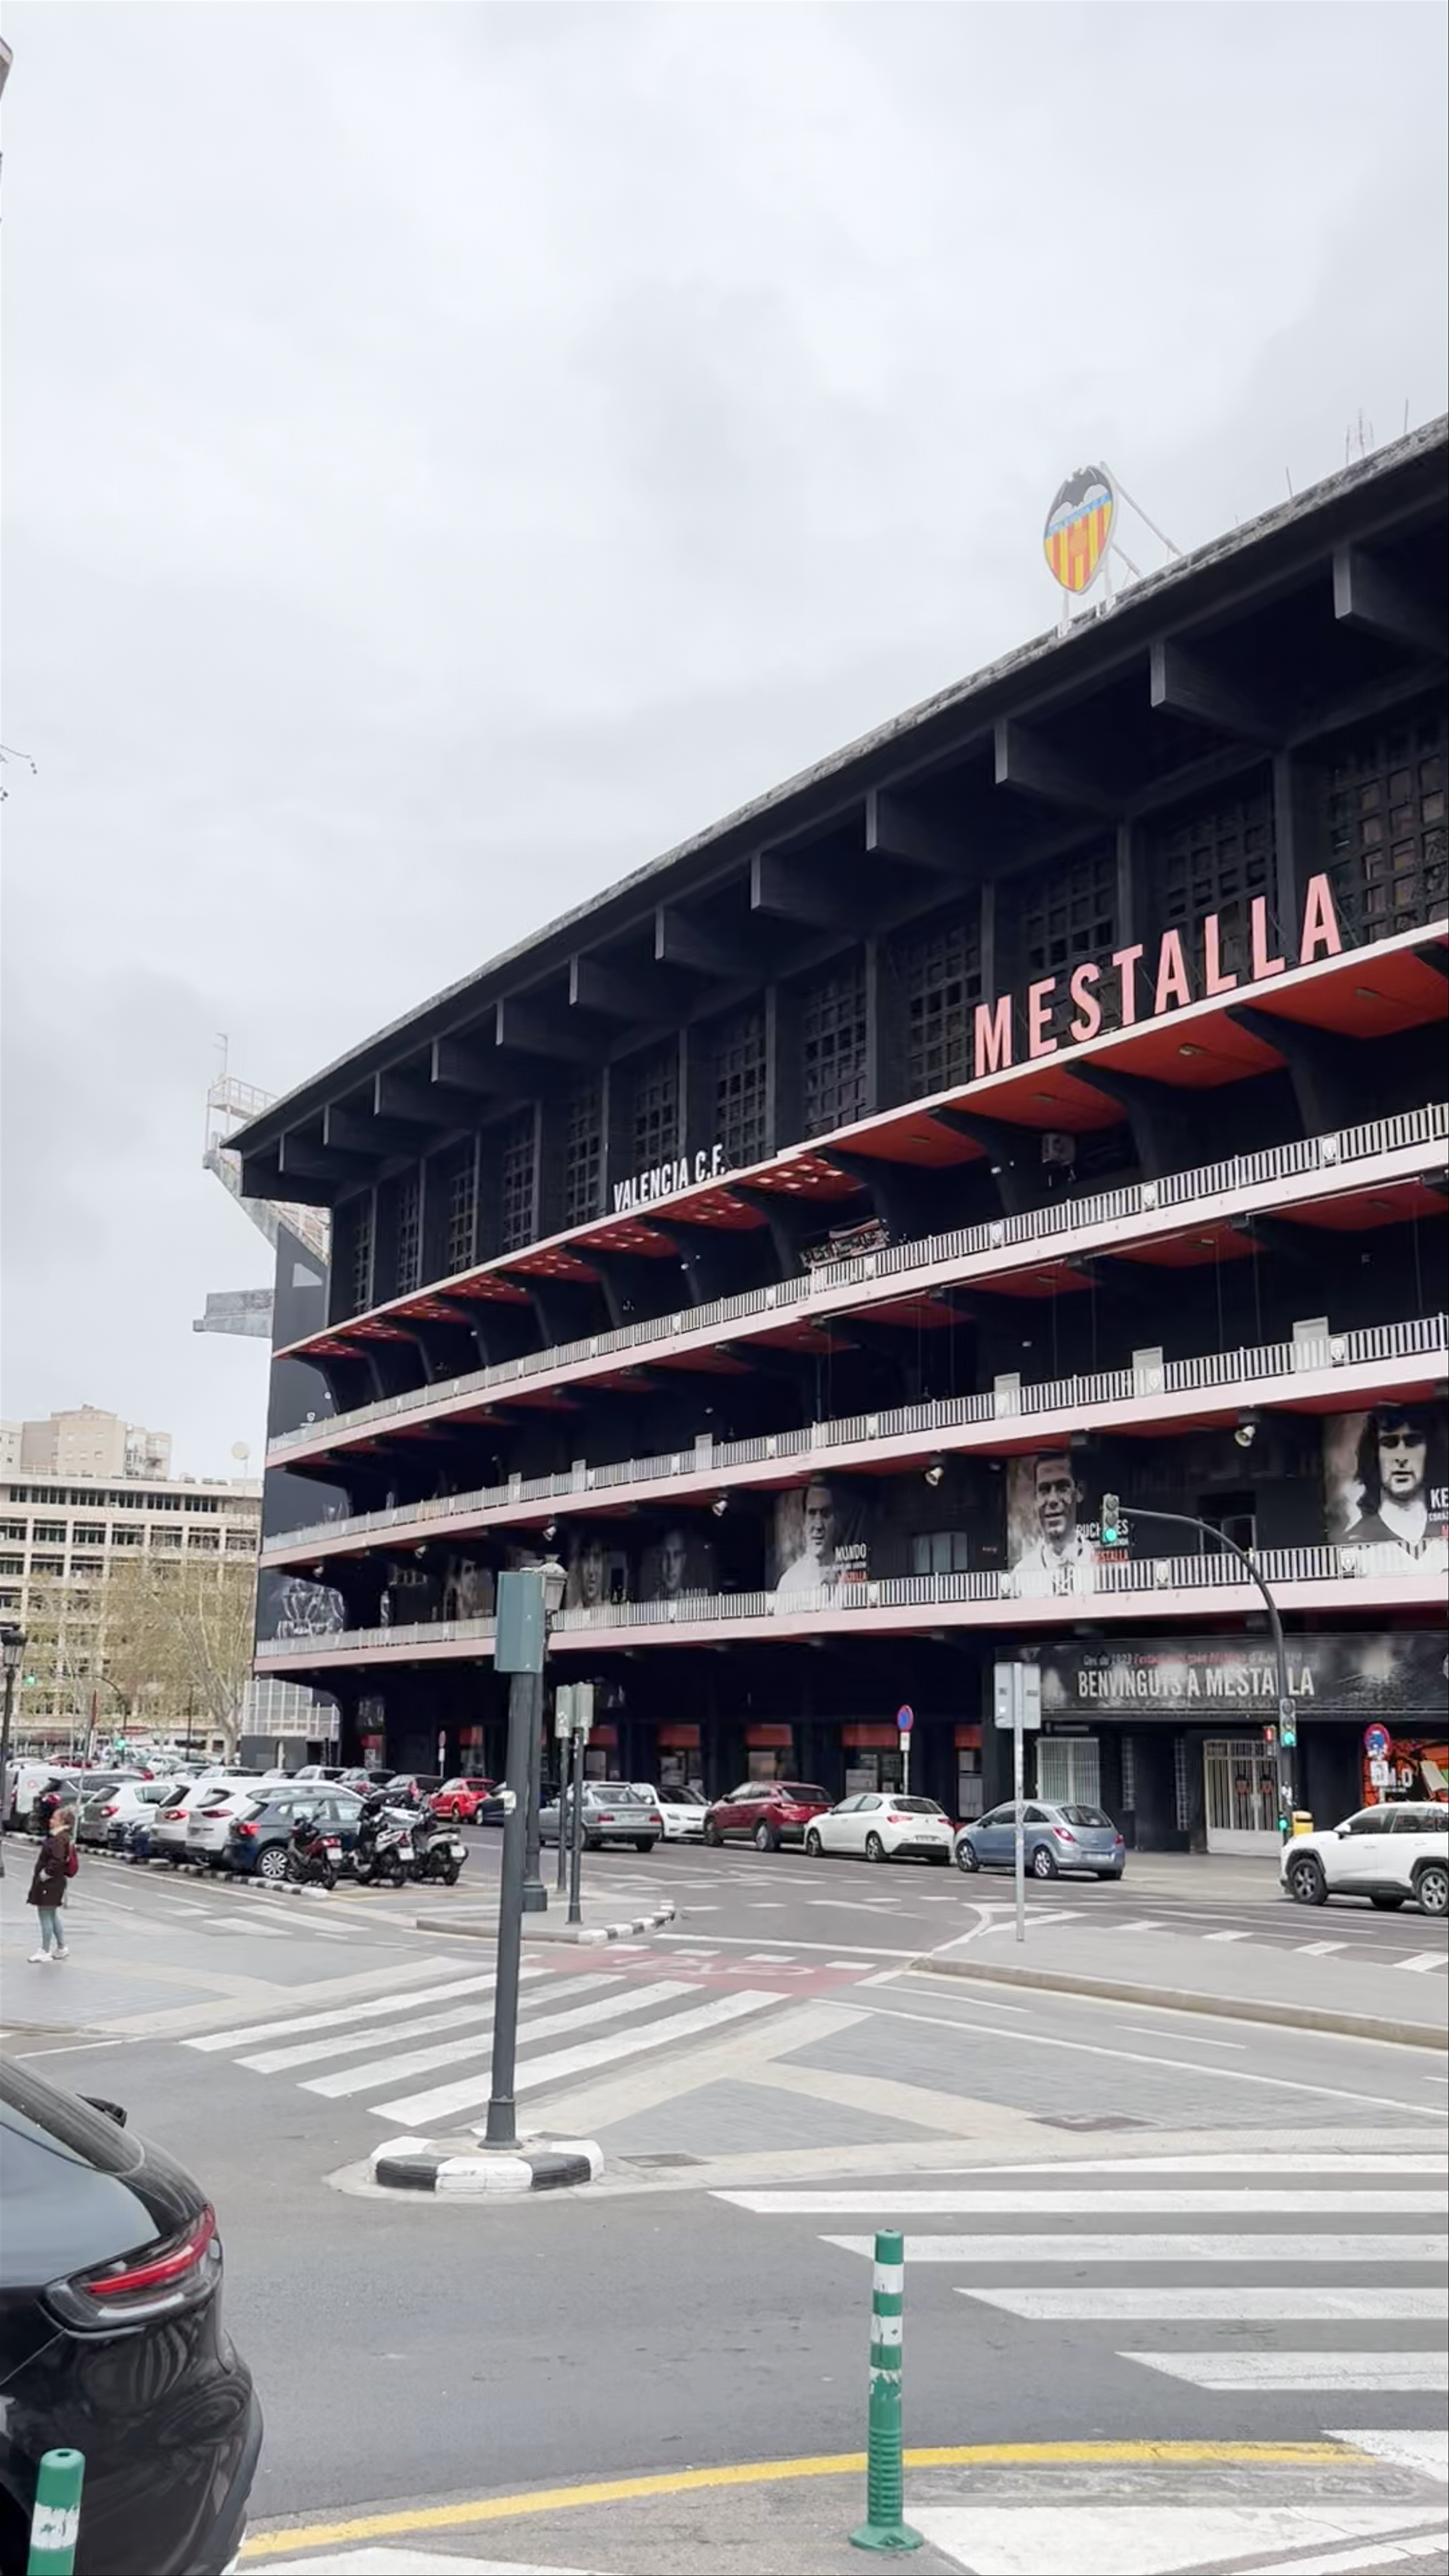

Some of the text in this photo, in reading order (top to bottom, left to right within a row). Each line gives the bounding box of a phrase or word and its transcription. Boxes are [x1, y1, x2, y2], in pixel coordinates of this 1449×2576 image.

[975, 873, 1342, 1077] MESTALLA
[614, 1144, 725, 1212] VALENCIA C.F.
[1076, 1519, 1128, 1538] PUCHES
[835, 1544, 867, 1561] MUNDO
[1078, 1669, 1182, 1697] BENVINGUTS
[1188, 1669, 1200, 1696] A
